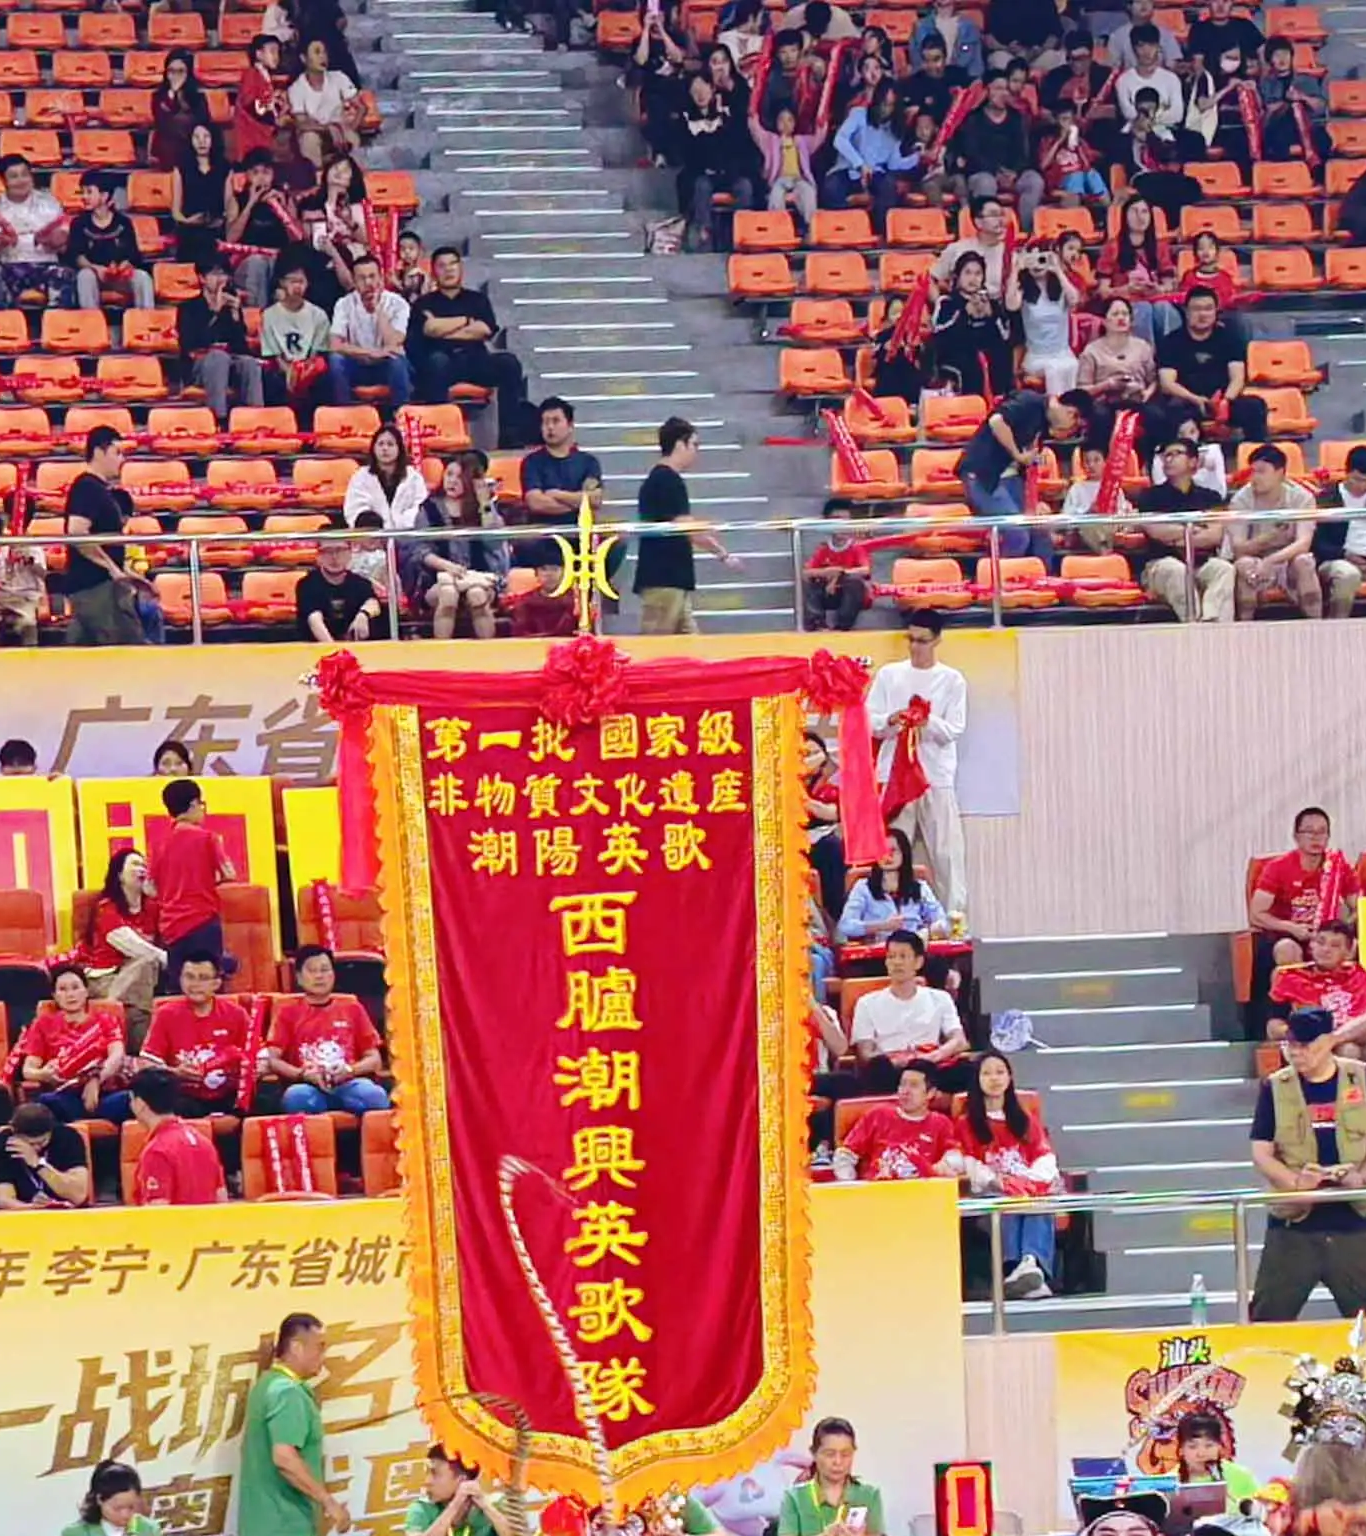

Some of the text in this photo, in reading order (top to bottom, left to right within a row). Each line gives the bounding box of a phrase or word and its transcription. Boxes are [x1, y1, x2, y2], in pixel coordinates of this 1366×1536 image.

[425, 716, 576, 763] 第一批
[599, 709, 742, 761] 國家級
[467, 820, 713, 876] 潮陽英歌
[1160, 1337, 1213, 1367] 汕头
